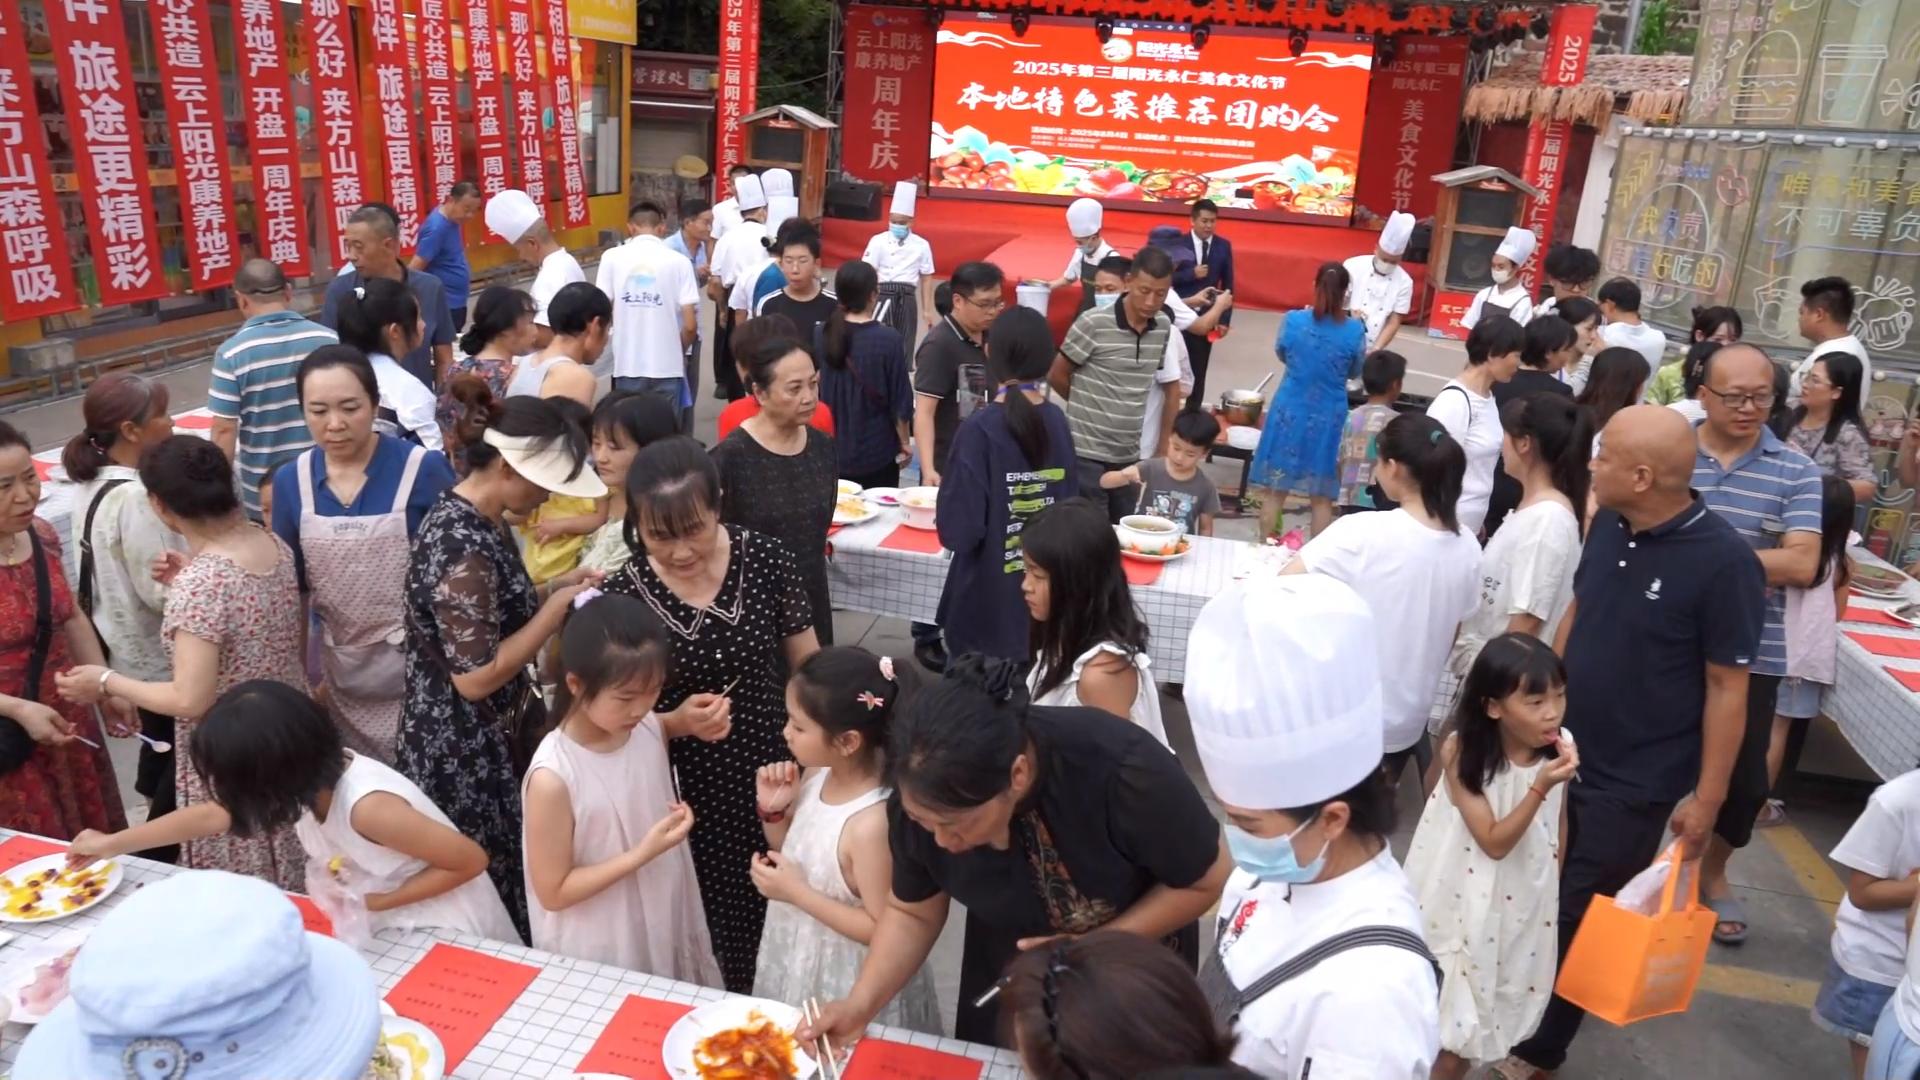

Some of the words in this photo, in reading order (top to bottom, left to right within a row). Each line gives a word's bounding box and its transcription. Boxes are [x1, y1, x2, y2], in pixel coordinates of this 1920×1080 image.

[421, 0, 449, 80] 匠心共造
[467, 0, 496, 90] 康养地产
[854, 51, 922, 71] 康养地产
[856, 30, 923, 51] 云上阳光
[1012, 60, 1287, 91] 2025年第三届阳光永仁美食文化节
[1379, 60, 1461, 76] 025年第三届
[1558, 35, 1582, 83] 2025
[555, 75, 585, 223] 旅途更精彩
[869, 76, 902, 170] 周年庆
[956, 80, 1340, 134] 本地特色菜推荐团购会
[68, 40, 151, 291] 旅途更精彩
[171, 76, 231, 281] 云上阳光康养地产
[252, 87, 301, 264] 开盘一周年庆典
[376, 64, 419, 249] 旅途更精彩
[517, 89, 546, 219] 来方山森呼
[1391, 100, 1424, 211] 美食文化节
[1774, 202, 1920, 242] 不可辜负
